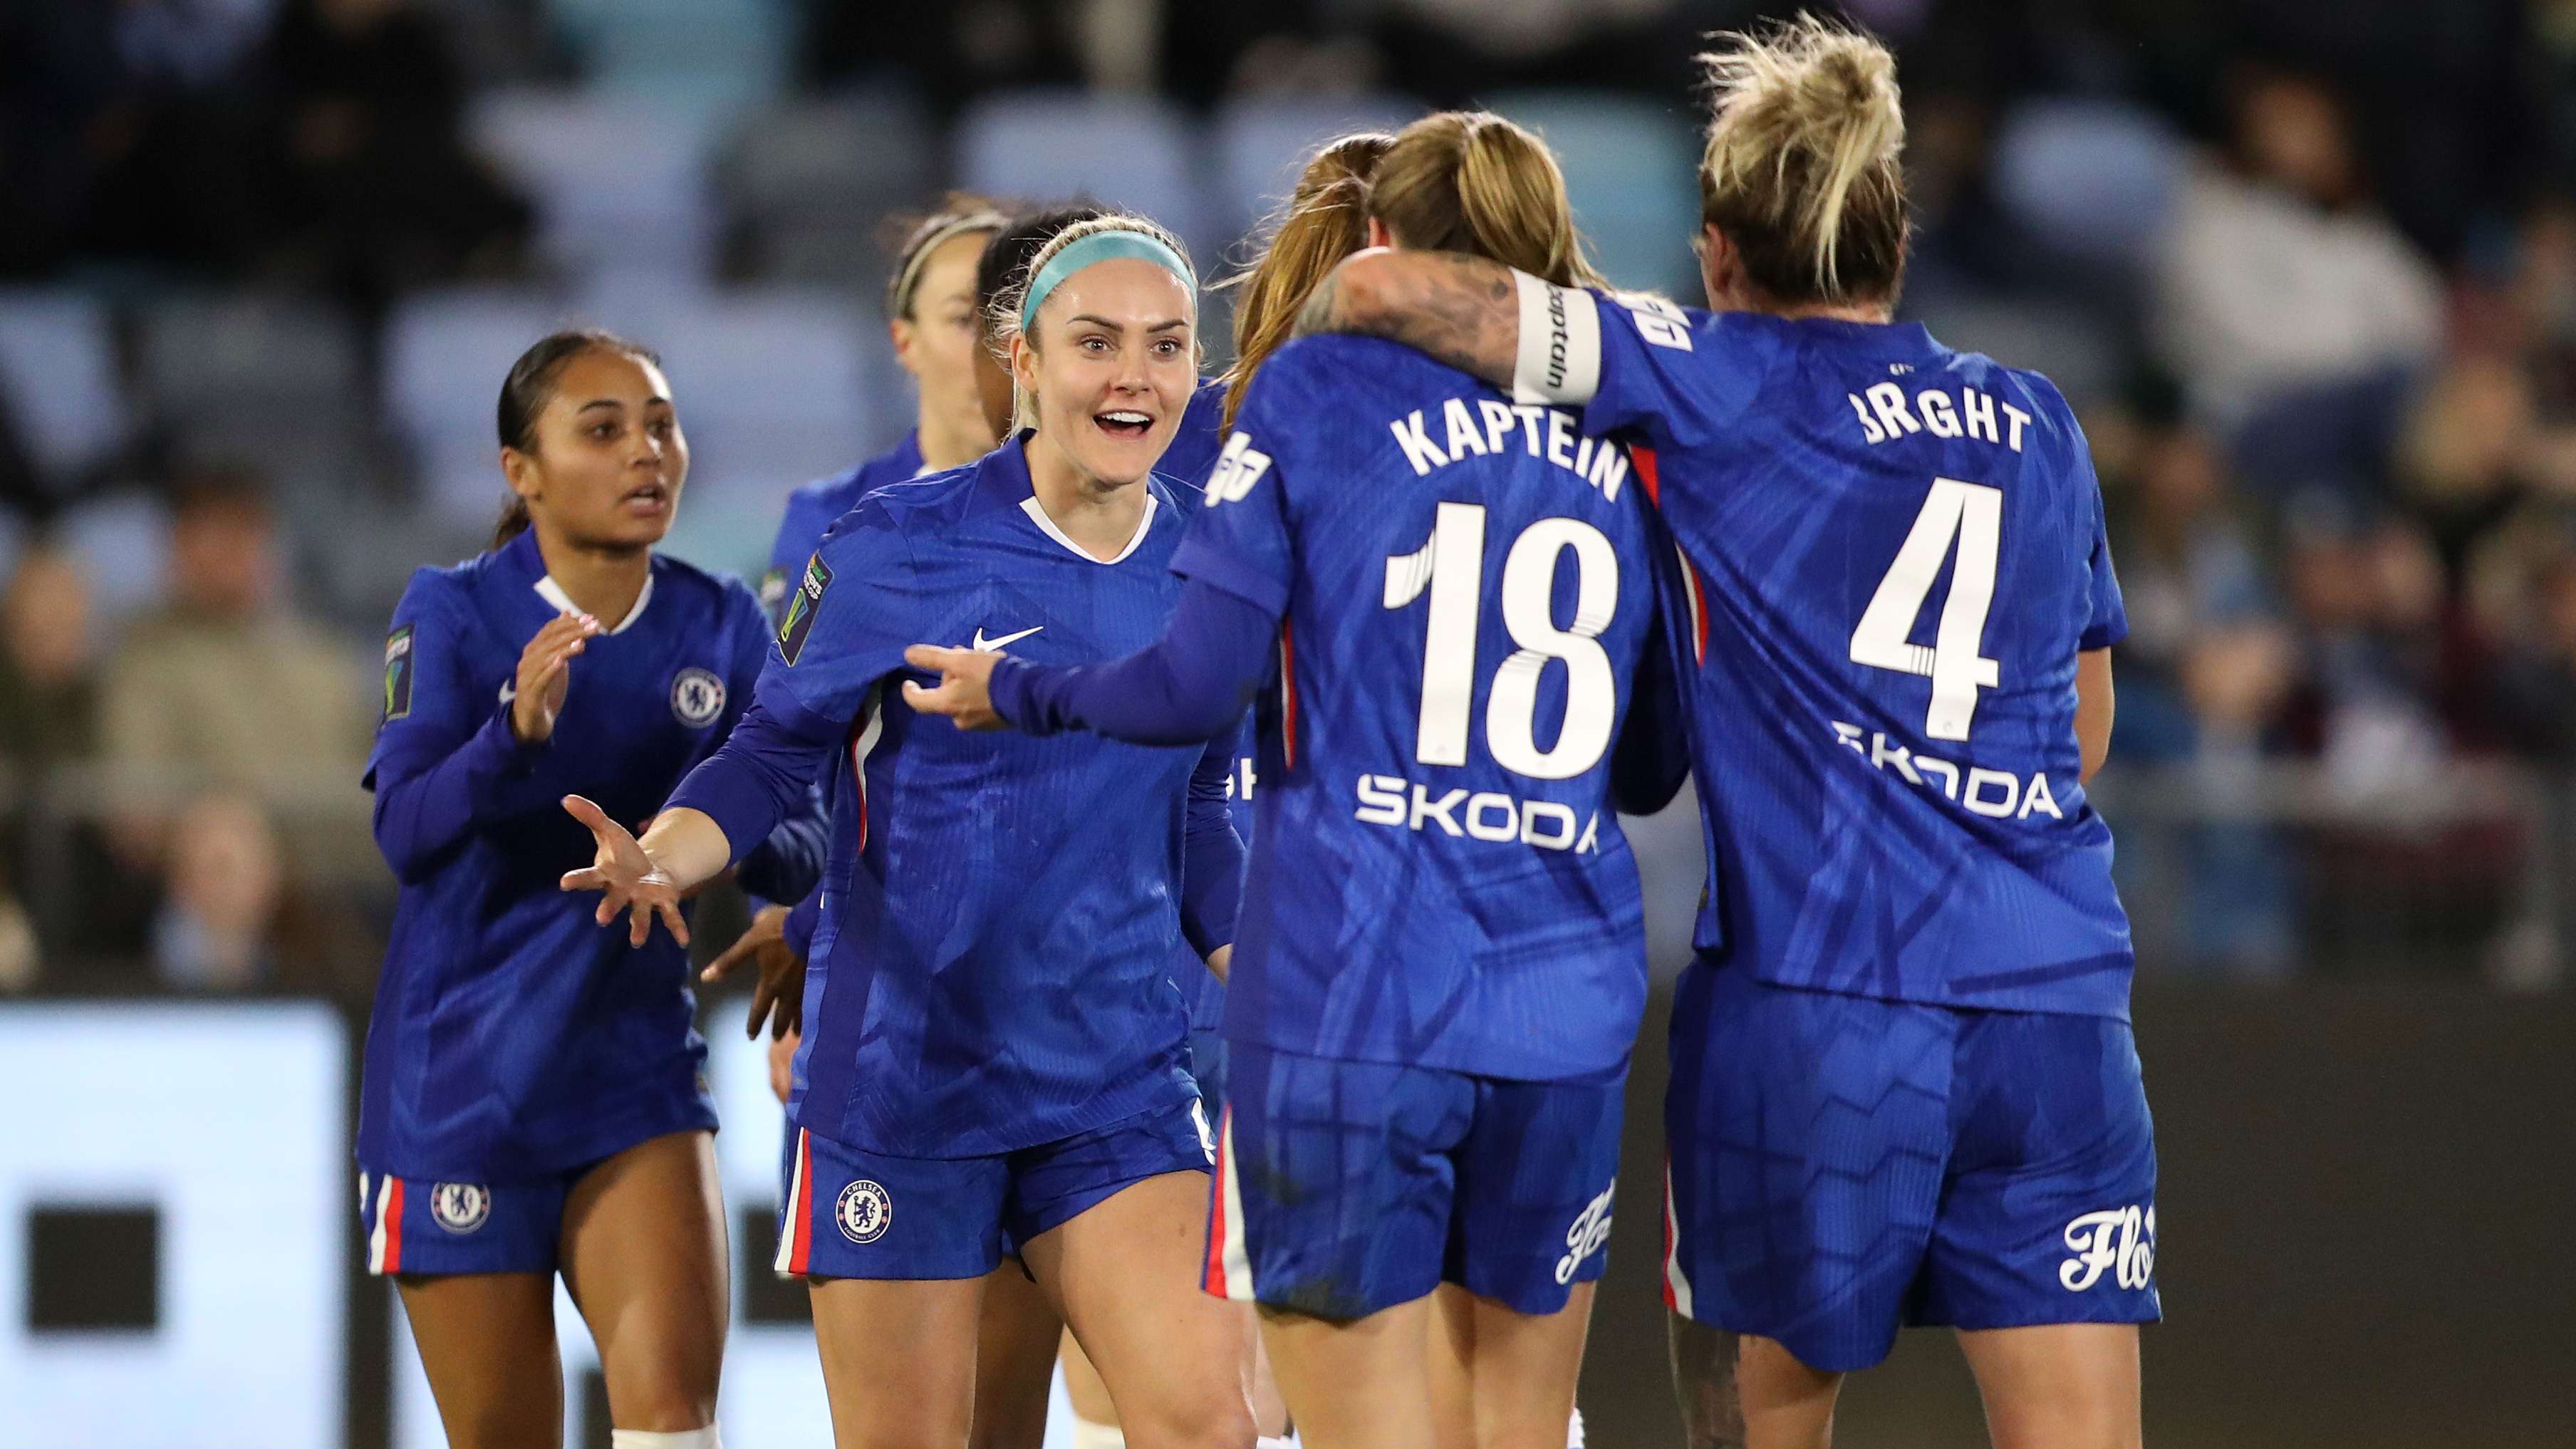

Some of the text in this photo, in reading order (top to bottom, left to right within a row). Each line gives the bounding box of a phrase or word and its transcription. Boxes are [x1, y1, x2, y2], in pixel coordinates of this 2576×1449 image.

[1389, 398, 1629, 503] KAPTEIN
[1849, 382, 2032, 452] BRGHT
[1383, 502, 1619, 780] 18
[1849, 477, 2003, 742] 4
[846, 1183, 882, 1198] CHELSEA
